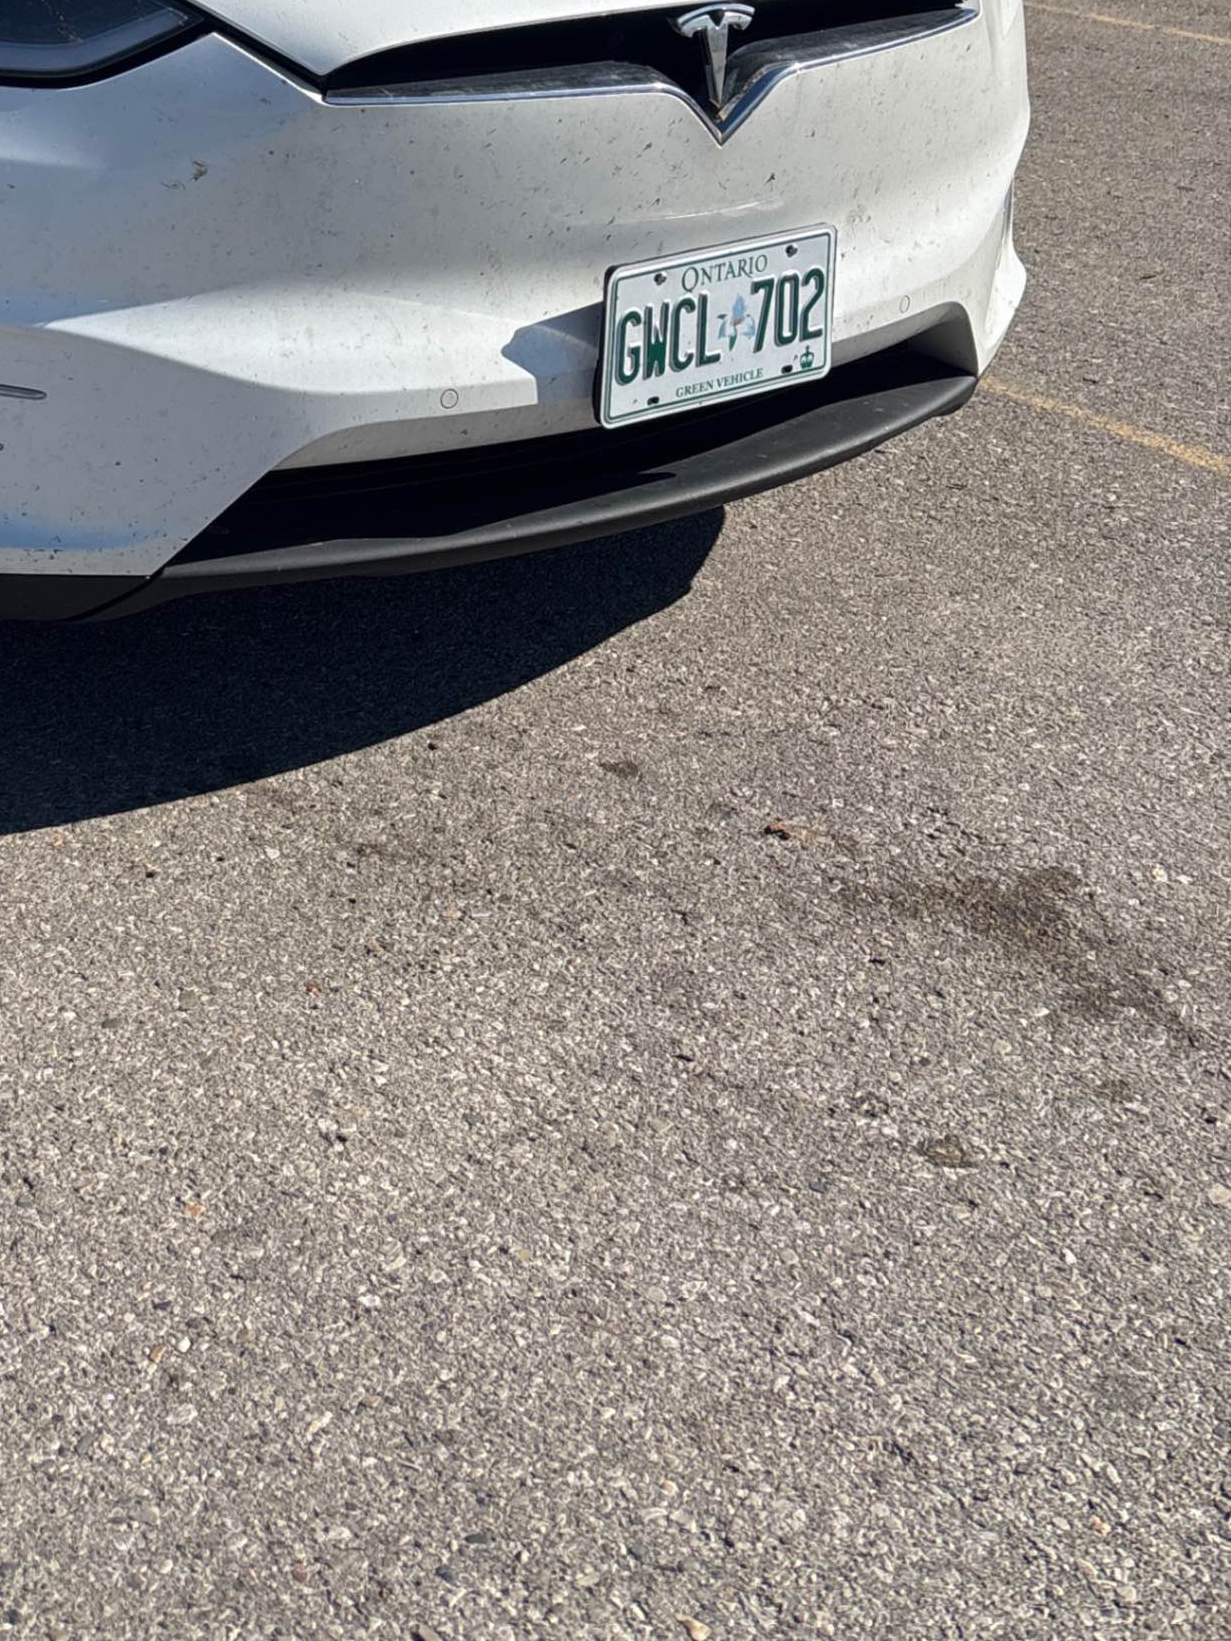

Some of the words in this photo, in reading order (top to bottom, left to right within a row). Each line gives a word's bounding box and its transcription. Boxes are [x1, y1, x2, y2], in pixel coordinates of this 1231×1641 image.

[681, 254, 768, 292] ONTARIO
[614, 291, 721, 386] GWCL
[750, 267, 825, 354] 702
[675, 380, 714, 398] GREEN
[716, 367, 764, 389] VEHICLE
